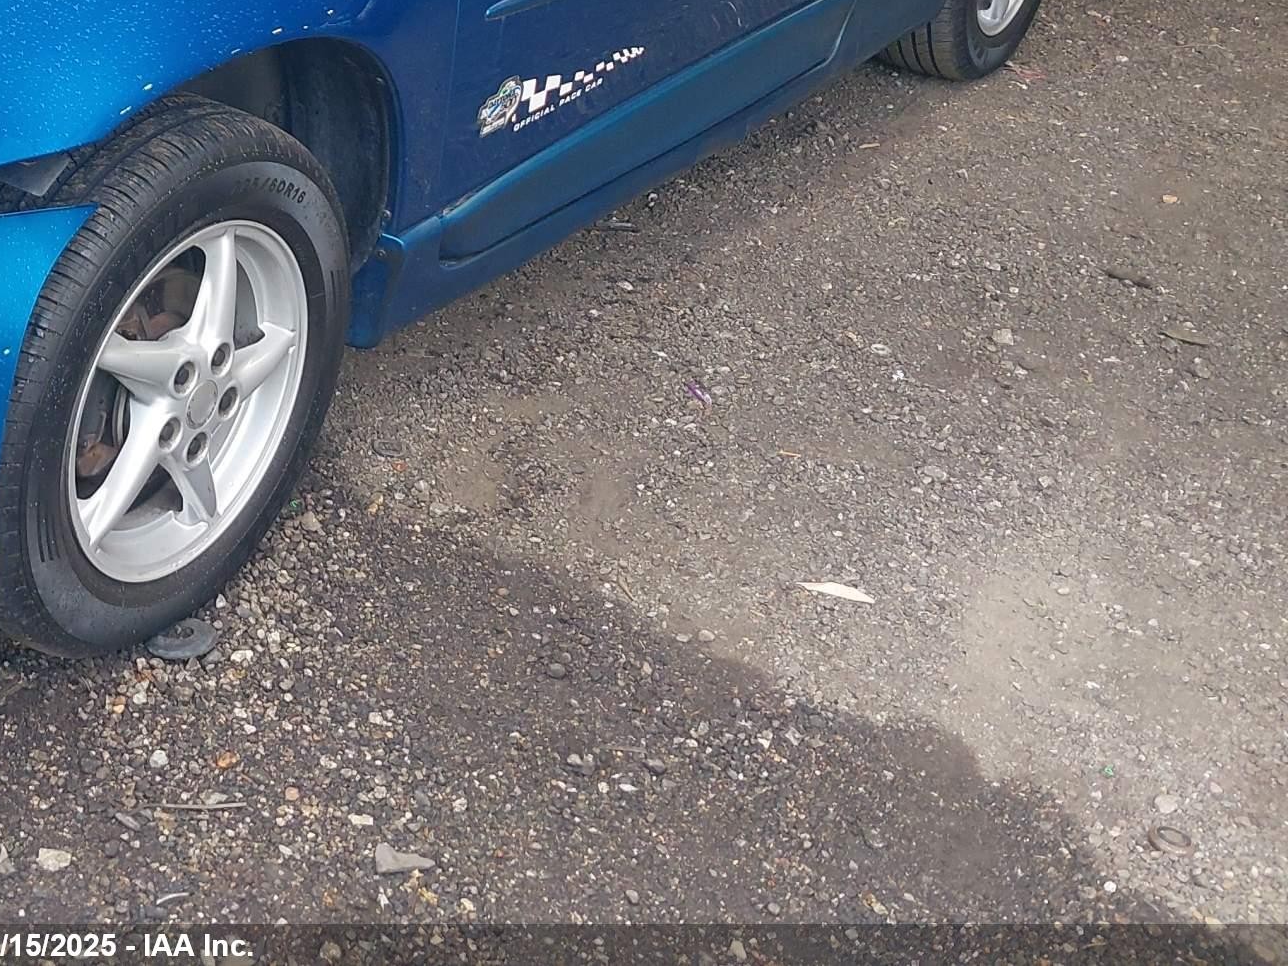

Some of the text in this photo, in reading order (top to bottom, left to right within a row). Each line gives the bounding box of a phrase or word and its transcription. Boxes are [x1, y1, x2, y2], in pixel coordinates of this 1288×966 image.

[513, 104, 555, 132] OFFICIAL
[558, 88, 583, 107] PACE
[585, 77, 604, 93] CAR
